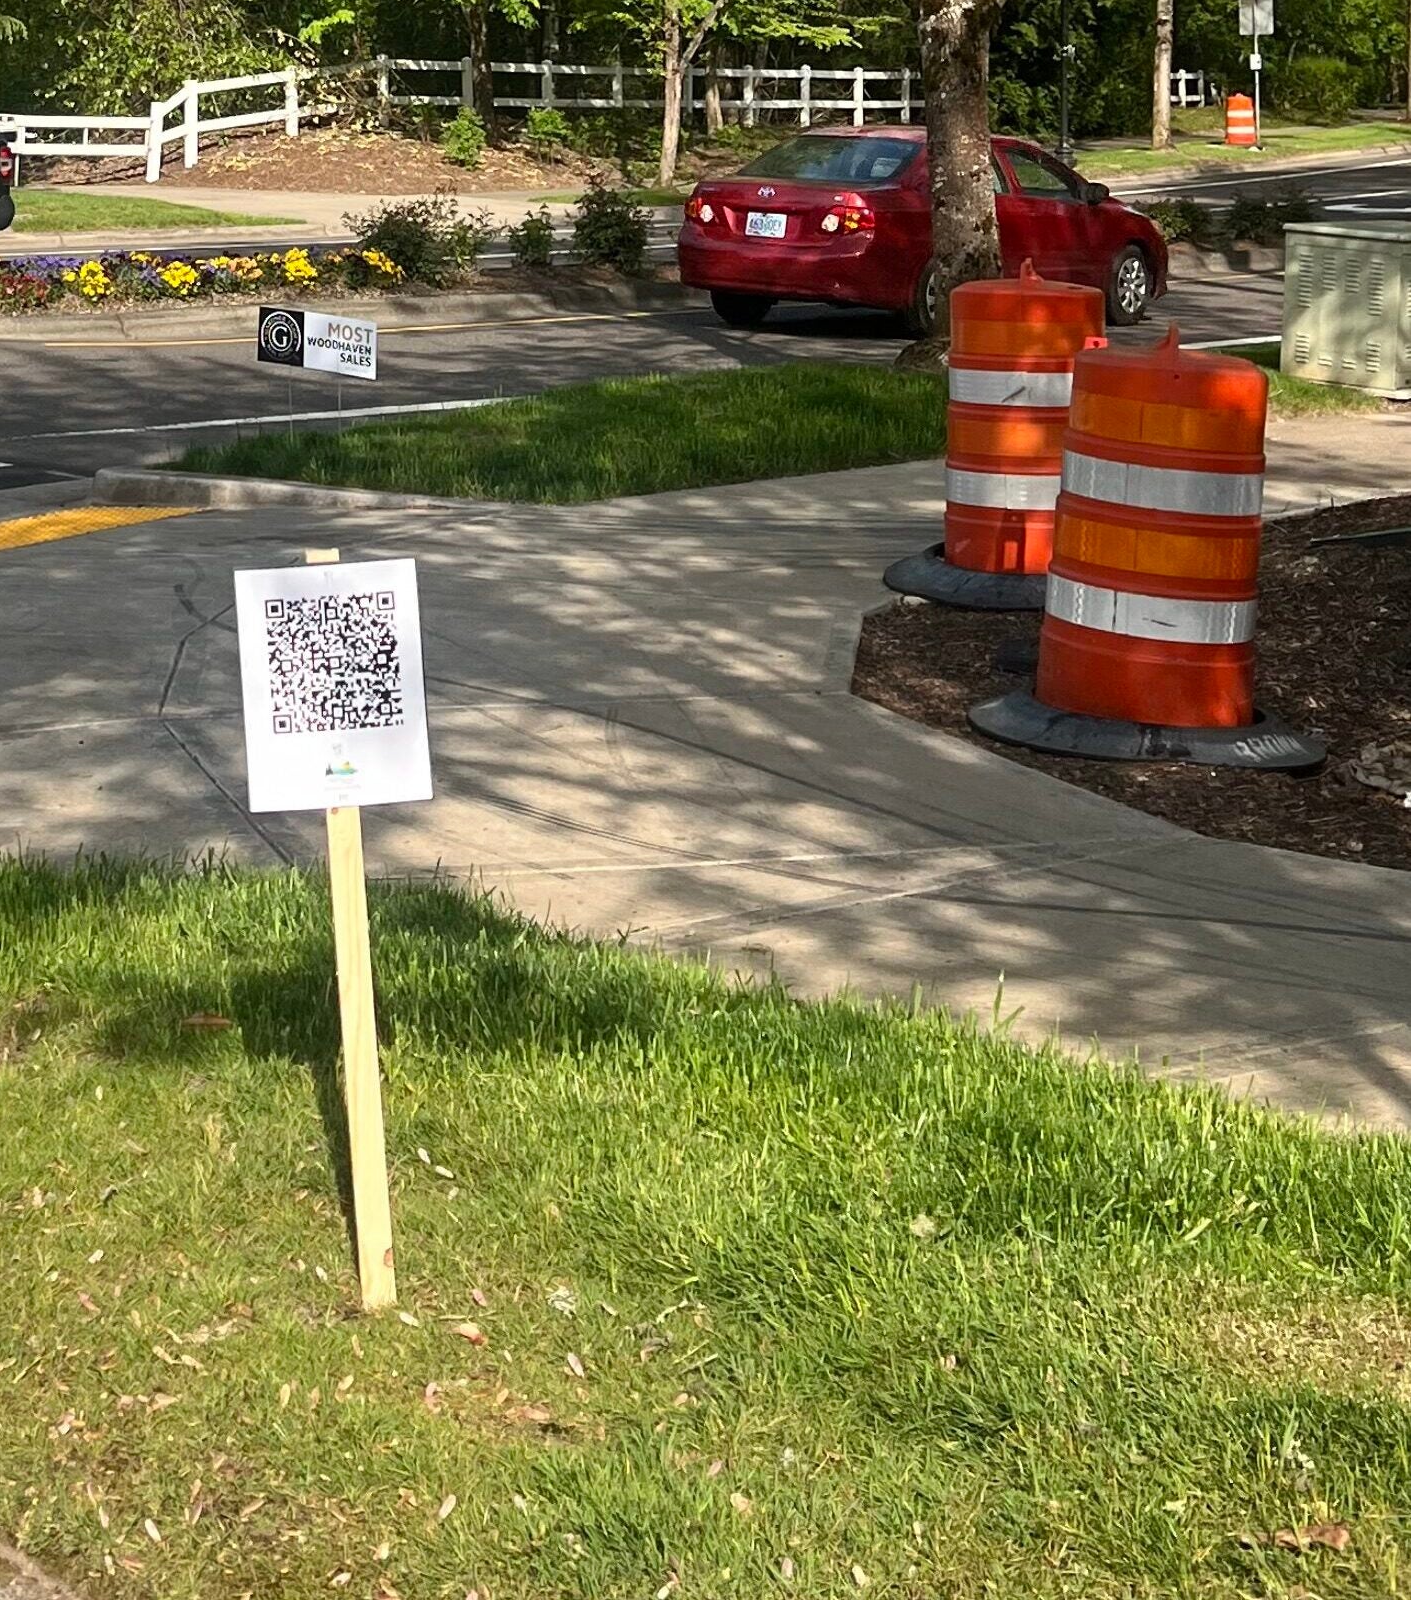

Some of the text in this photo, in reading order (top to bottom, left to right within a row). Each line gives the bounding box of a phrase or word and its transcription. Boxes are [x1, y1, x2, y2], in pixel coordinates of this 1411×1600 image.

[272, 326, 289, 347] G
[327, 322, 374, 344] MOST
[307, 336, 372, 355] WOODHAVEN
[340, 352, 372, 367] SALES
